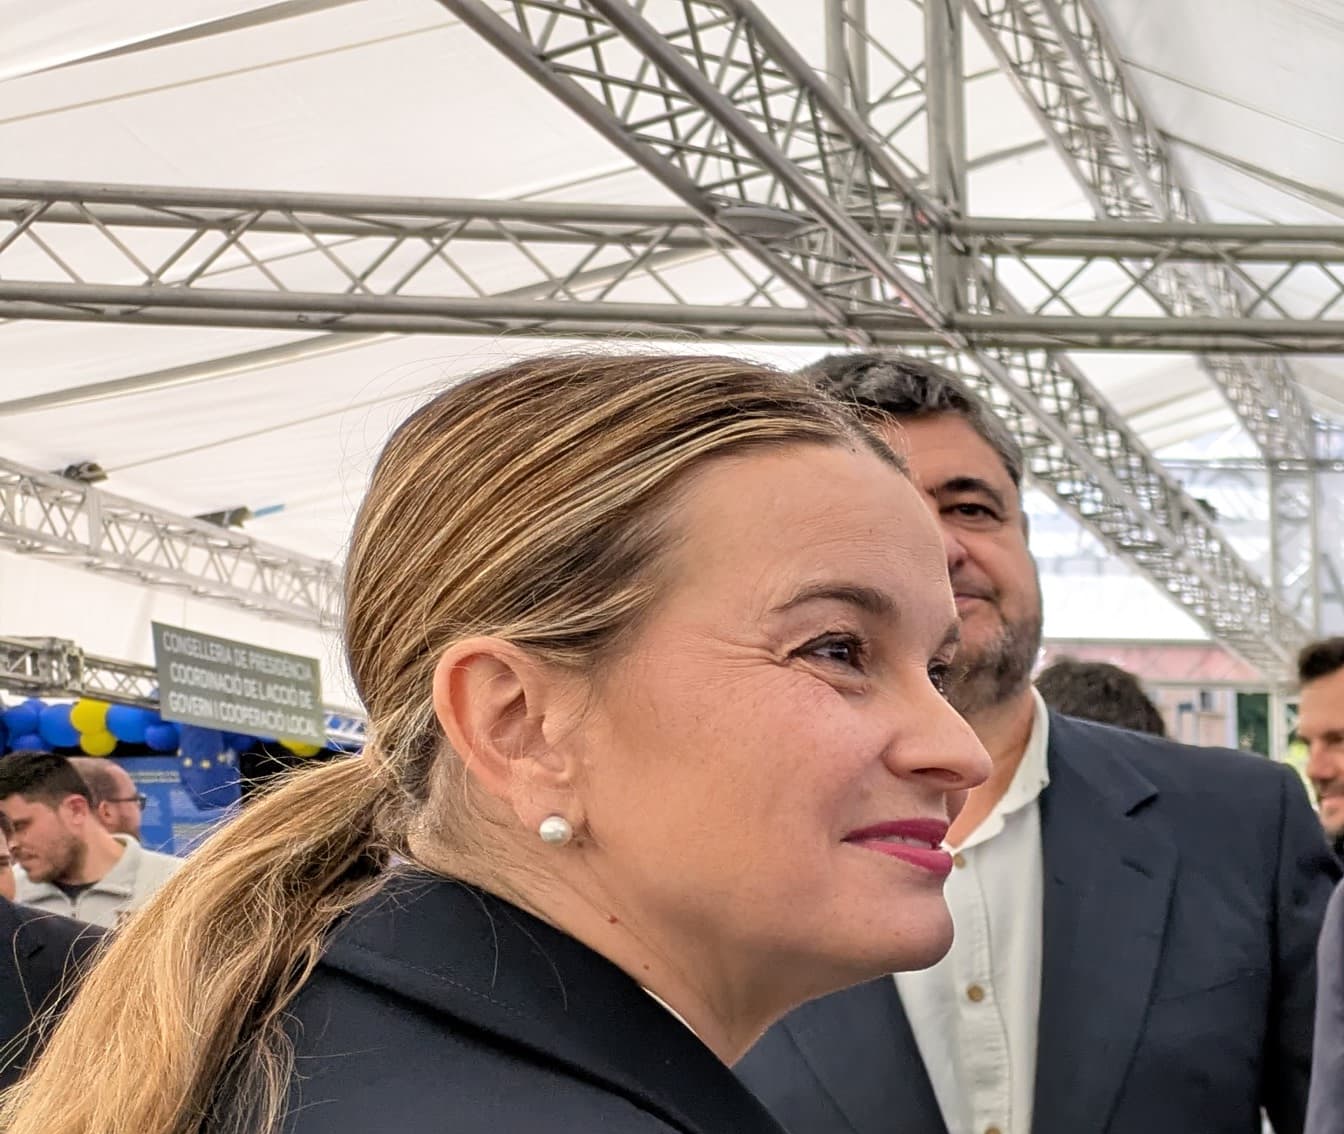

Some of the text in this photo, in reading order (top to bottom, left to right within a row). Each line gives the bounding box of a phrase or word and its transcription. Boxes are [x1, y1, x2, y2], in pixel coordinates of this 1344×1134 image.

[233, 648, 248, 670] DE
[170, 662, 242, 695] COORDINACIÓ
[243, 677, 258, 700] DE
[299, 687, 313, 710] DE
[169, 691, 213, 716] GOVERN
[220, 701, 285, 731] COOPERACIÓ
[287, 713, 319, 737] LOCAL
